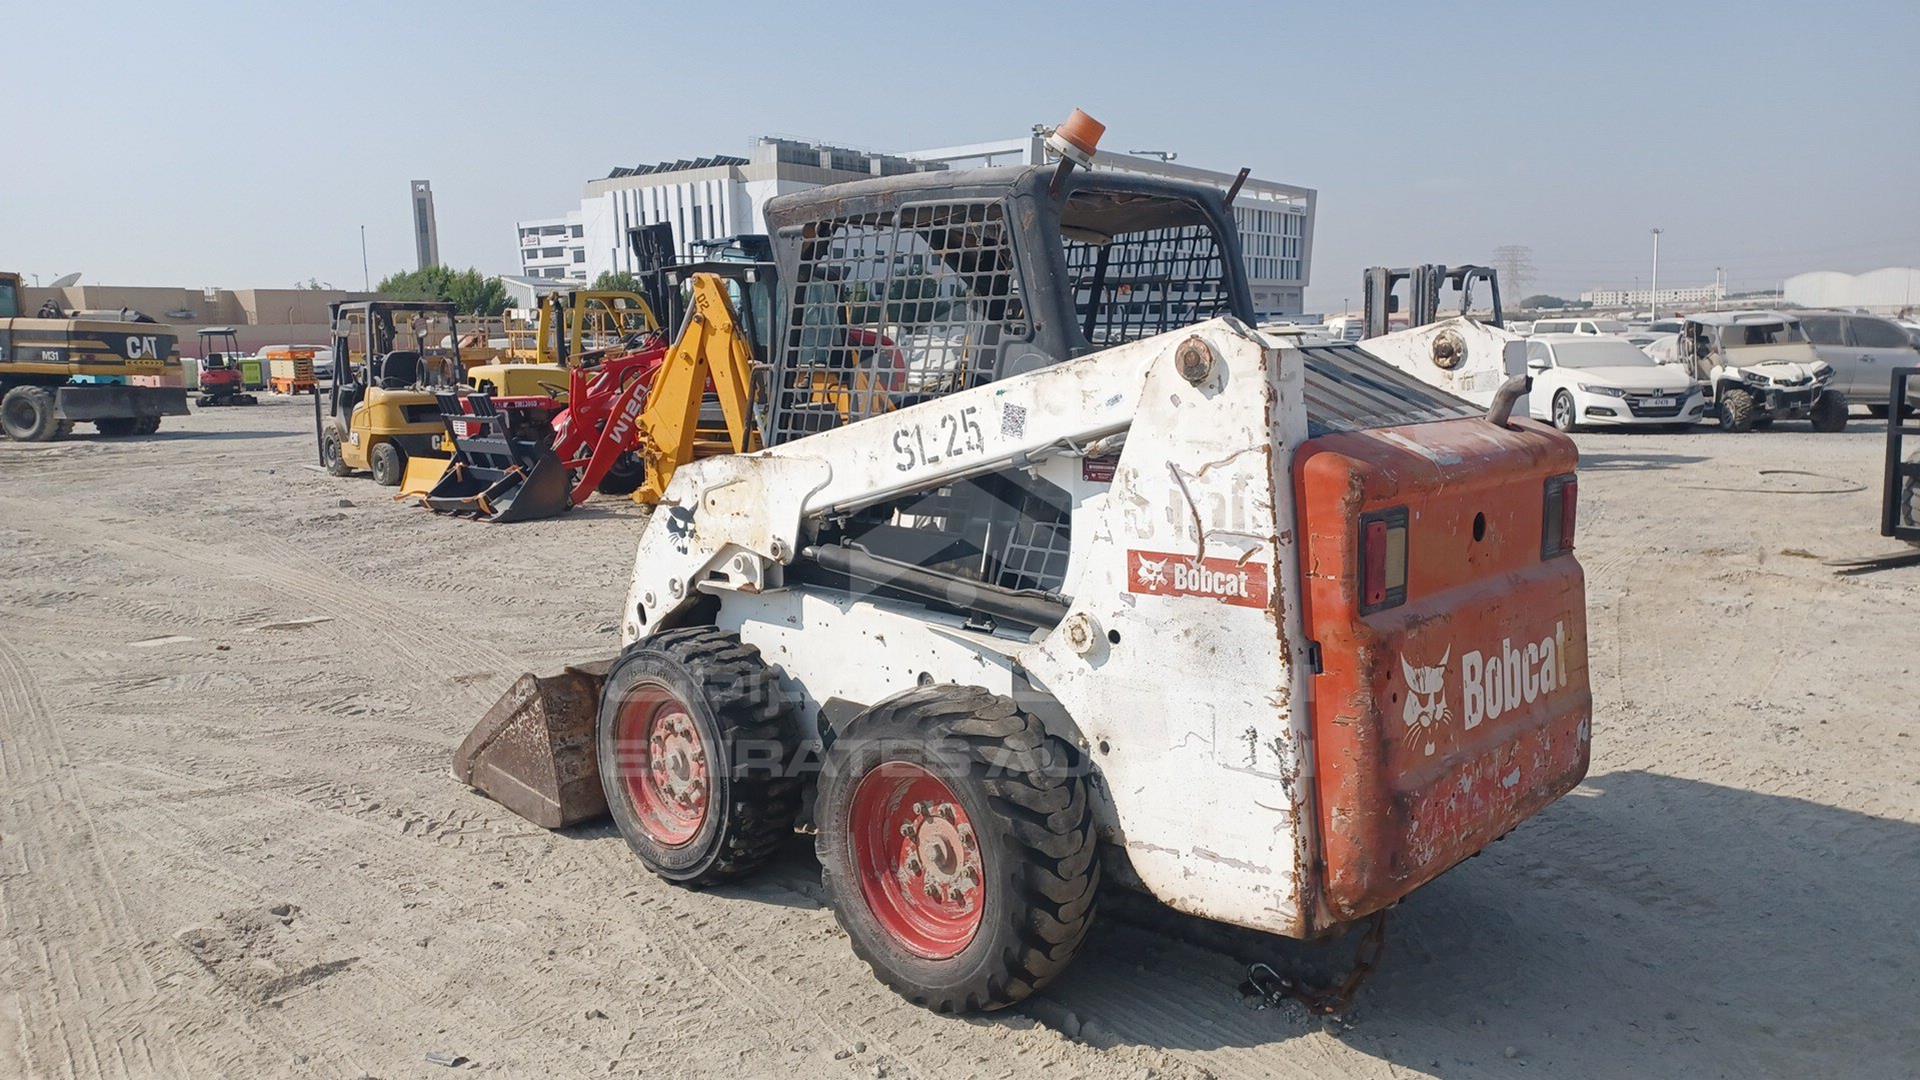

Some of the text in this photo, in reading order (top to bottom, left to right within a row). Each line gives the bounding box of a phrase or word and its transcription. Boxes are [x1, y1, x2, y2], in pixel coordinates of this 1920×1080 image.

[126, 336, 158, 360] CAT
[1174, 562, 1249, 598] Bobcat
[1461, 620, 1568, 731] Bobcat
